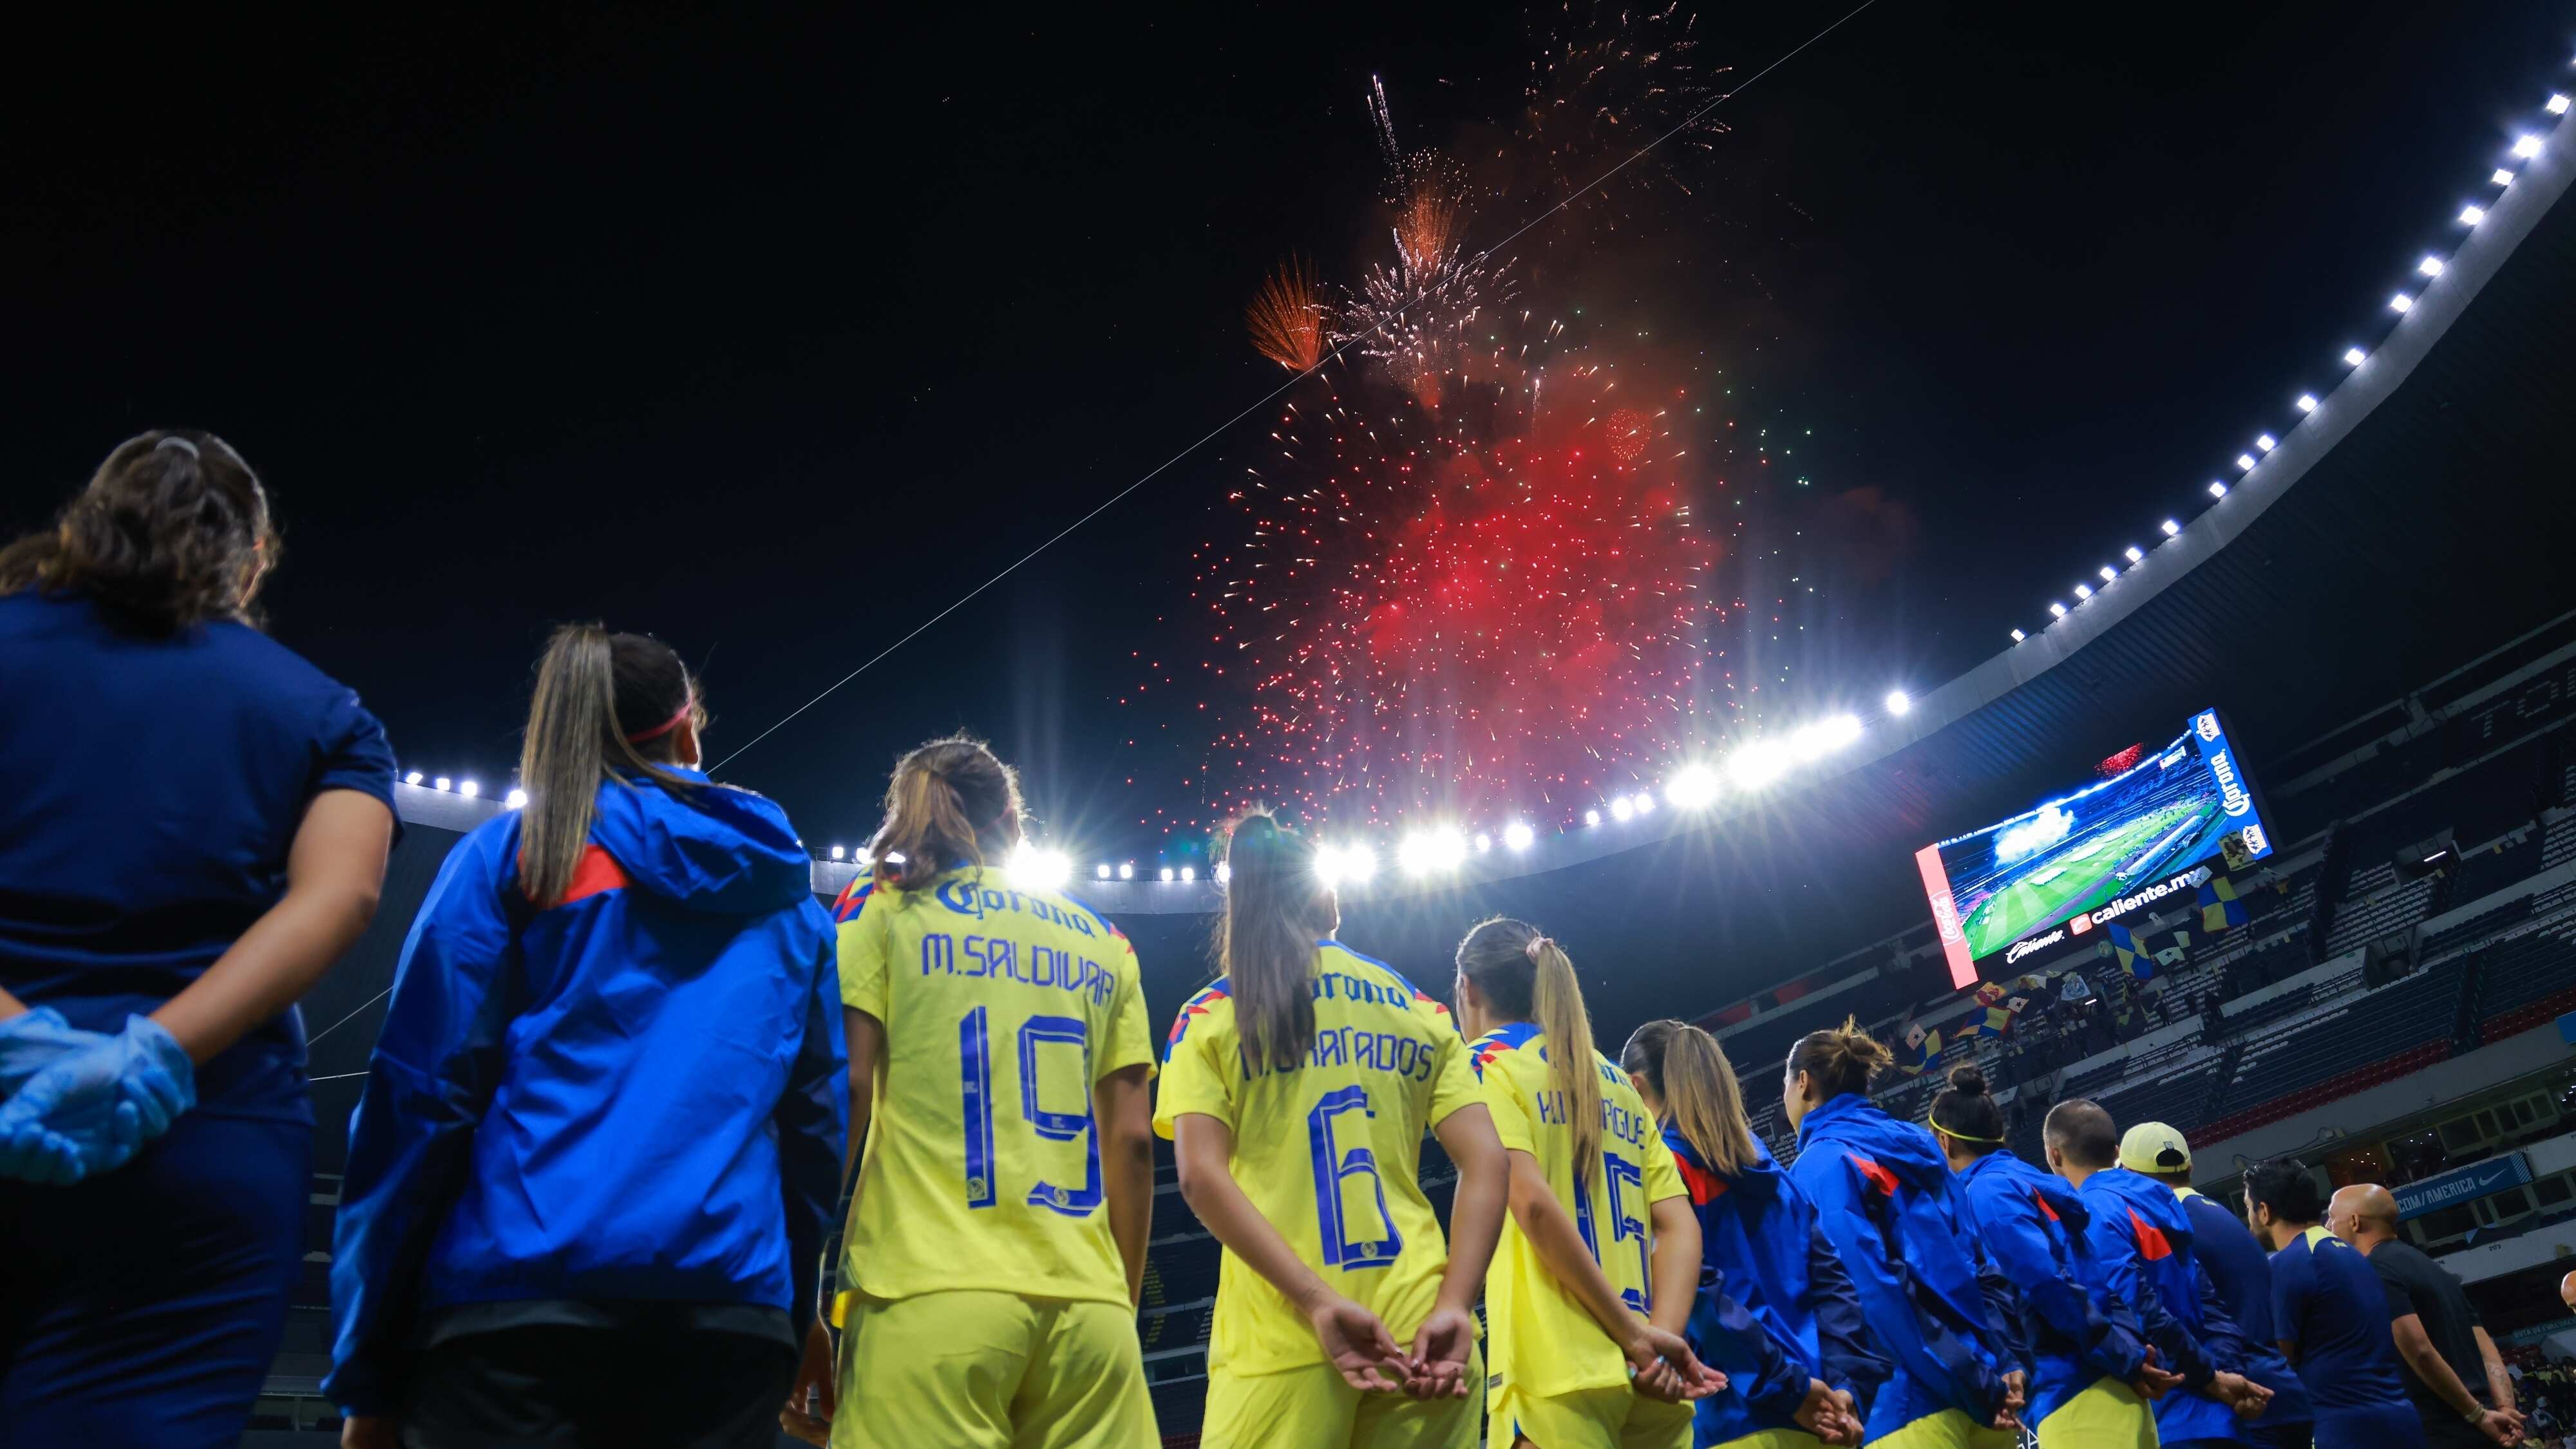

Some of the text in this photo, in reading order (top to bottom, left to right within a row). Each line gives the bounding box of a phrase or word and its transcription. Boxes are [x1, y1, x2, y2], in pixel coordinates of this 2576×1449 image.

[2211, 748, 2250, 817] Corona
[936, 878, 1097, 940] Corona
[2091, 871, 2195, 925] caliente.m
[1312, 972, 1410, 1011] rona
[1238, 1026, 1434, 1083] .ANADOS
[959, 1005, 1108, 1218] 19
[1307, 1084, 1404, 1273] 6
